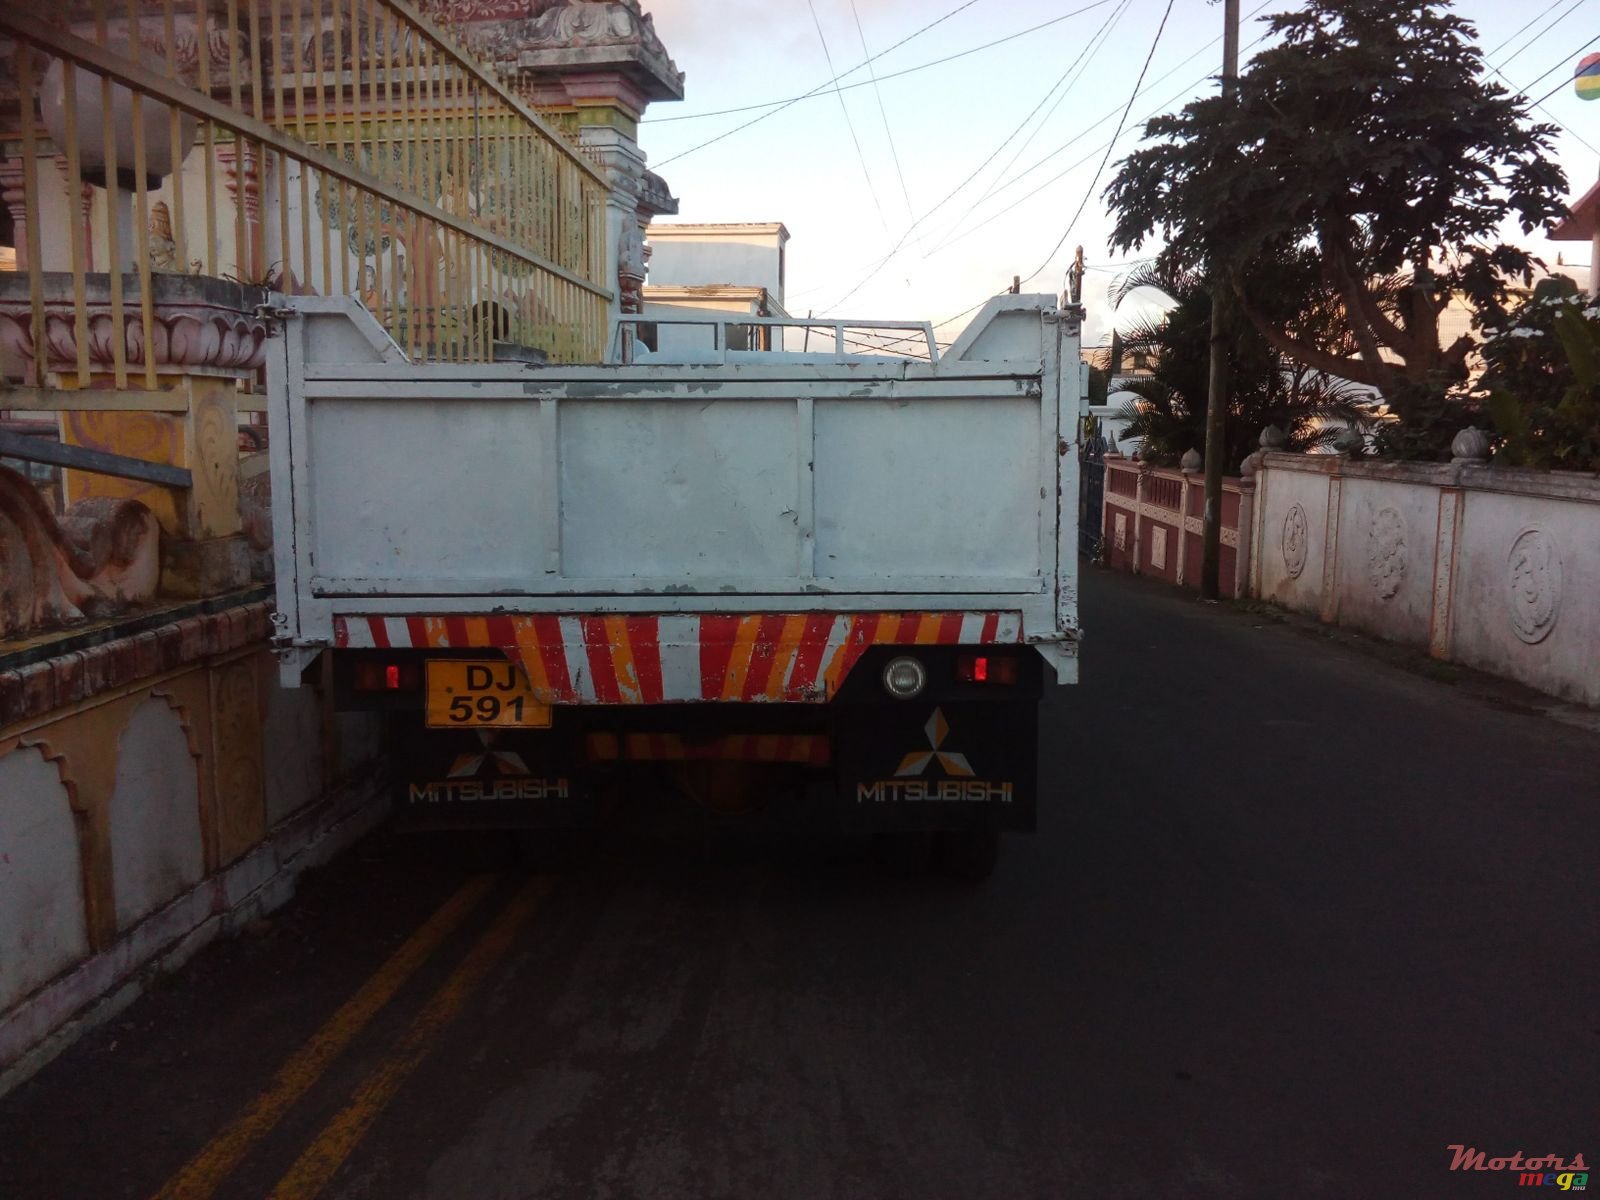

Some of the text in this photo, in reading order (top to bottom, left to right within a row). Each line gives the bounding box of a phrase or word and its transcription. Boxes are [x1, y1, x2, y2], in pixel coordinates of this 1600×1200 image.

[467, 664, 517, 691] DJ
[448, 695, 525, 722] 591
[408, 778, 569, 804] MITSUBISHI
[857, 780, 1013, 804] MITSUBISHI
